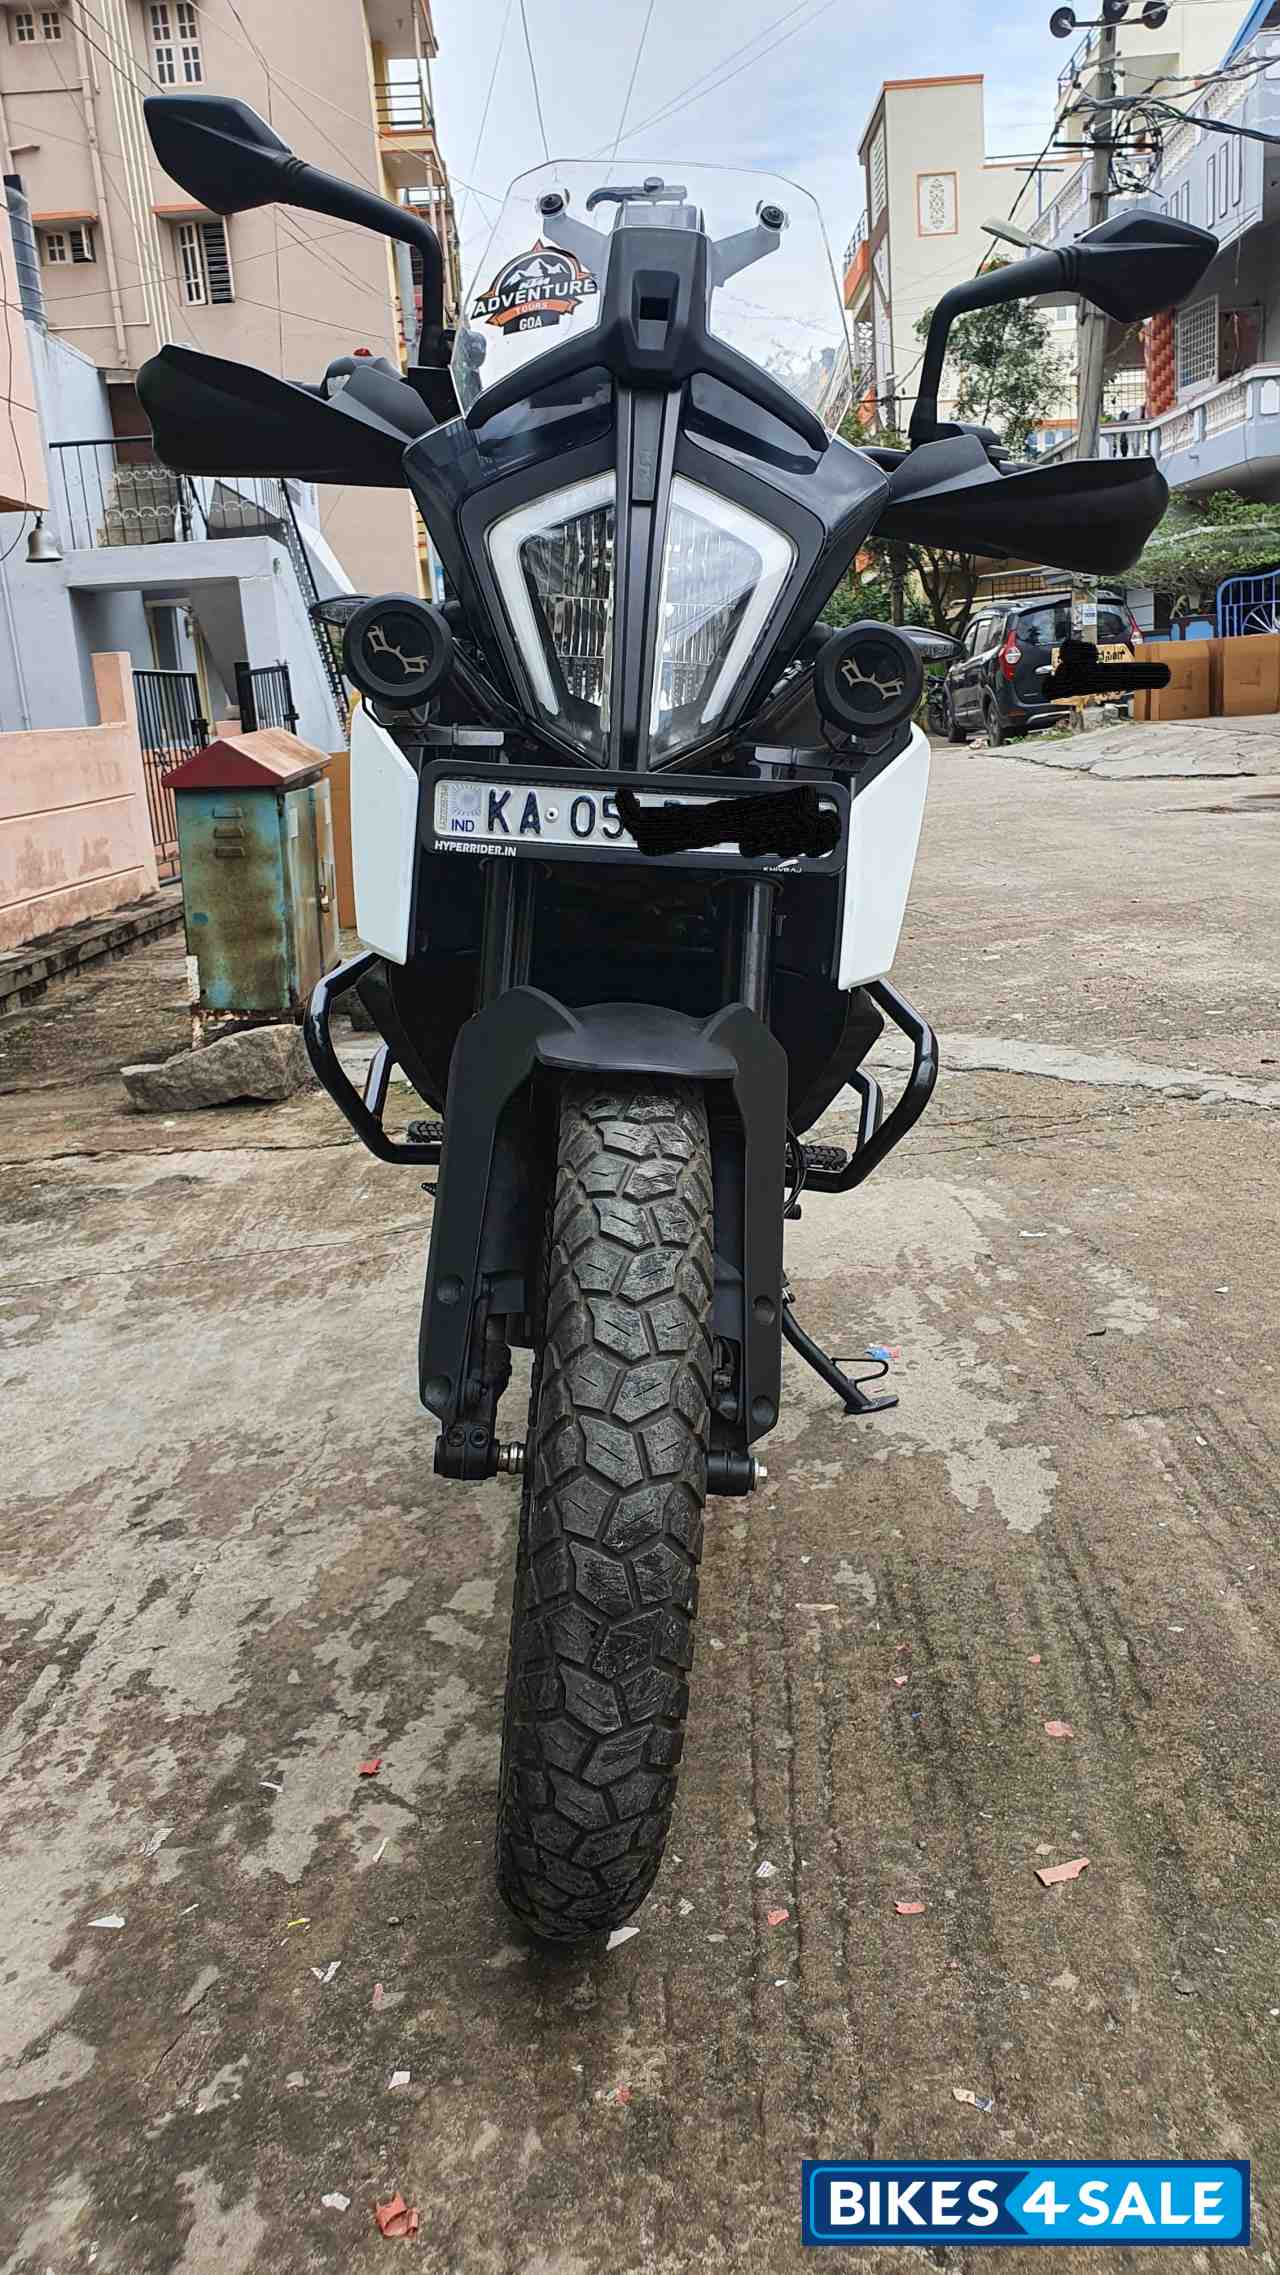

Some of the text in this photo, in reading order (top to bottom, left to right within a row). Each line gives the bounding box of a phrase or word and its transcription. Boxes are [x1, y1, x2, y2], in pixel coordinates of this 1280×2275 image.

[475, 280, 595, 314] ADVENTURE
[517, 301, 548, 314] TOURS
[519, 316, 542, 331] GOA
[487, 788, 541, 834] KA
[571, 794, 624, 840] 05
[451, 818, 475, 832] IND
[435, 840, 517, 857] HYPERRIDER.IN
